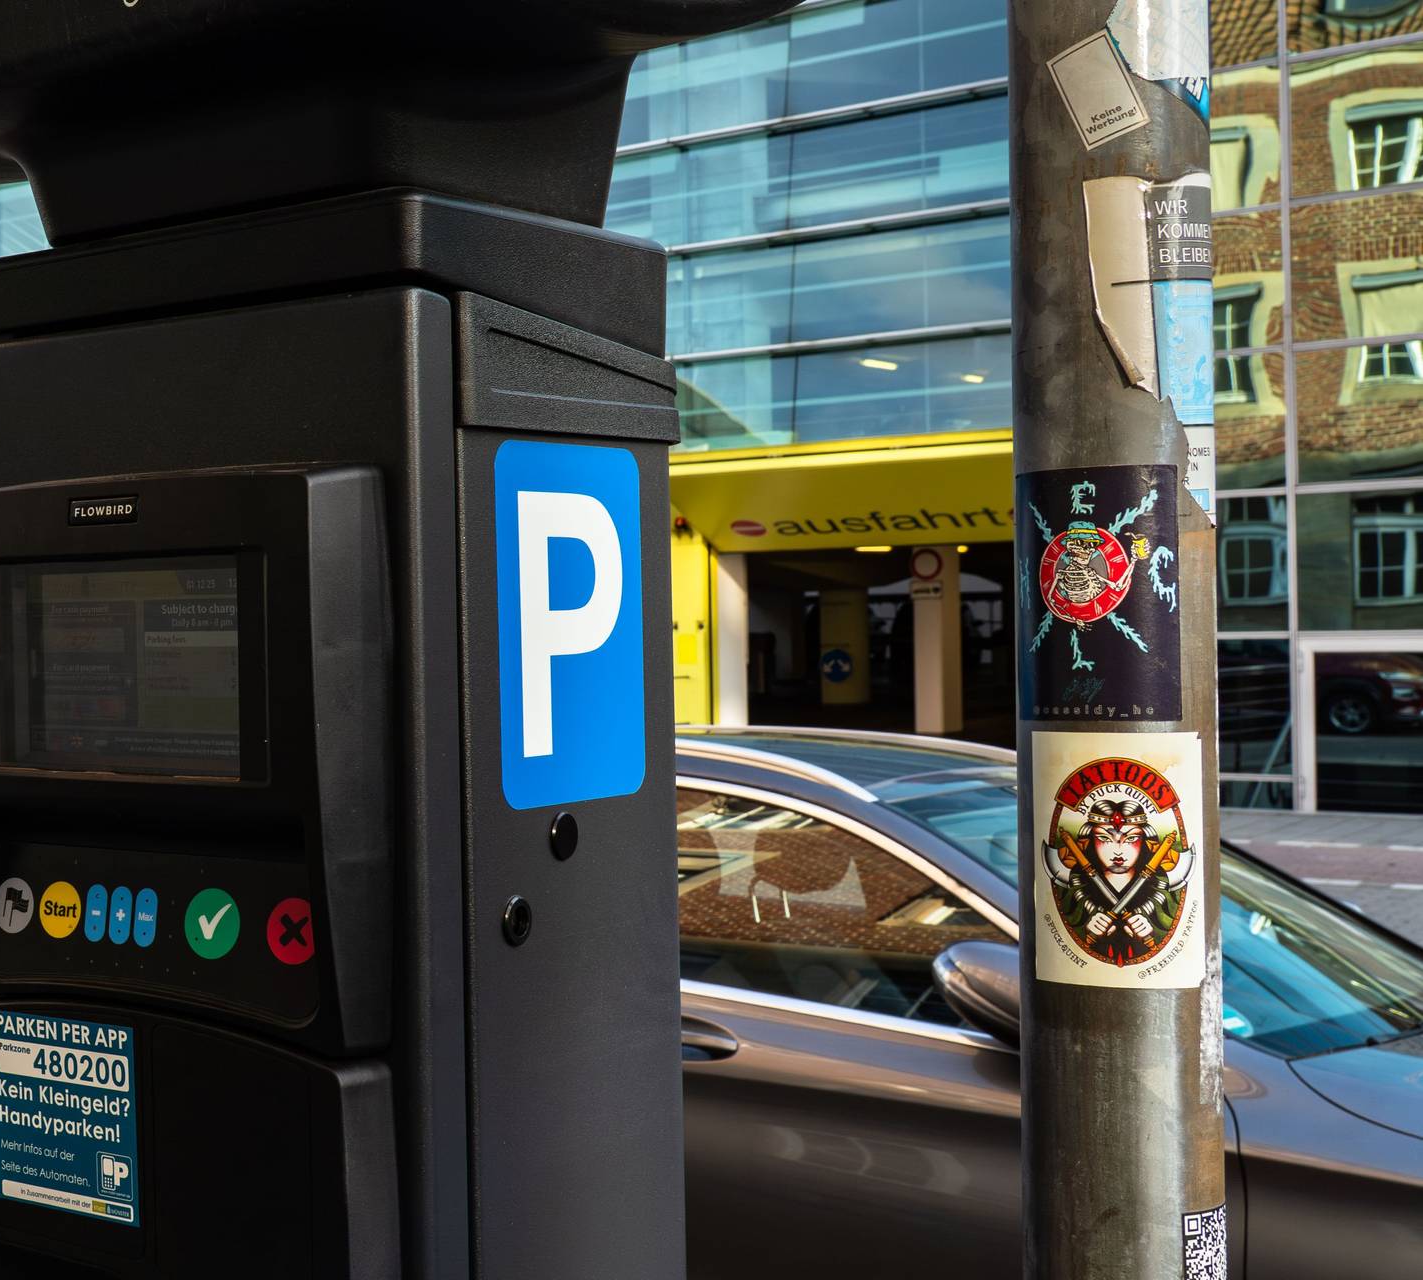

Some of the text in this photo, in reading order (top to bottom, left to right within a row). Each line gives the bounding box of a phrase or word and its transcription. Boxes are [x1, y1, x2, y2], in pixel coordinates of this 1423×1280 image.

[1086, 106, 1137, 134] Werbung!
[1091, 105, 1122, 123] Keine
[1155, 199, 1188, 215] WIR
[74, 503, 133, 518] FLOWBIRD
[773, 507, 1008, 536] ausfahrt
[161, 603, 195, 617] Subject
[197, 604, 207, 614] to
[517, 490, 623, 758] P
[1065, 761, 1170, 801] TATTOOS
[1078, 784, 1158, 816] BY PUCK QUINT
[43, 899, 78, 919] Start
[138, 910, 154, 922] Max
[62, 1022, 91, 1046] PER
[94, 1027, 128, 1050] APP
[33, 1048, 126, 1087] 480200
[39, 1084, 130, 1118] Kleingeld?
[0, 1139, 75, 1162] Mehr Infos auf der
[1, 1160, 91, 1187] Seite des Automaten.
[114, 1161, 129, 1187] P
[27, 1189, 71, 1205] Zusammenarbeit
[71, 1199, 81, 1207] mit
[81, 1200, 91, 1209] der
